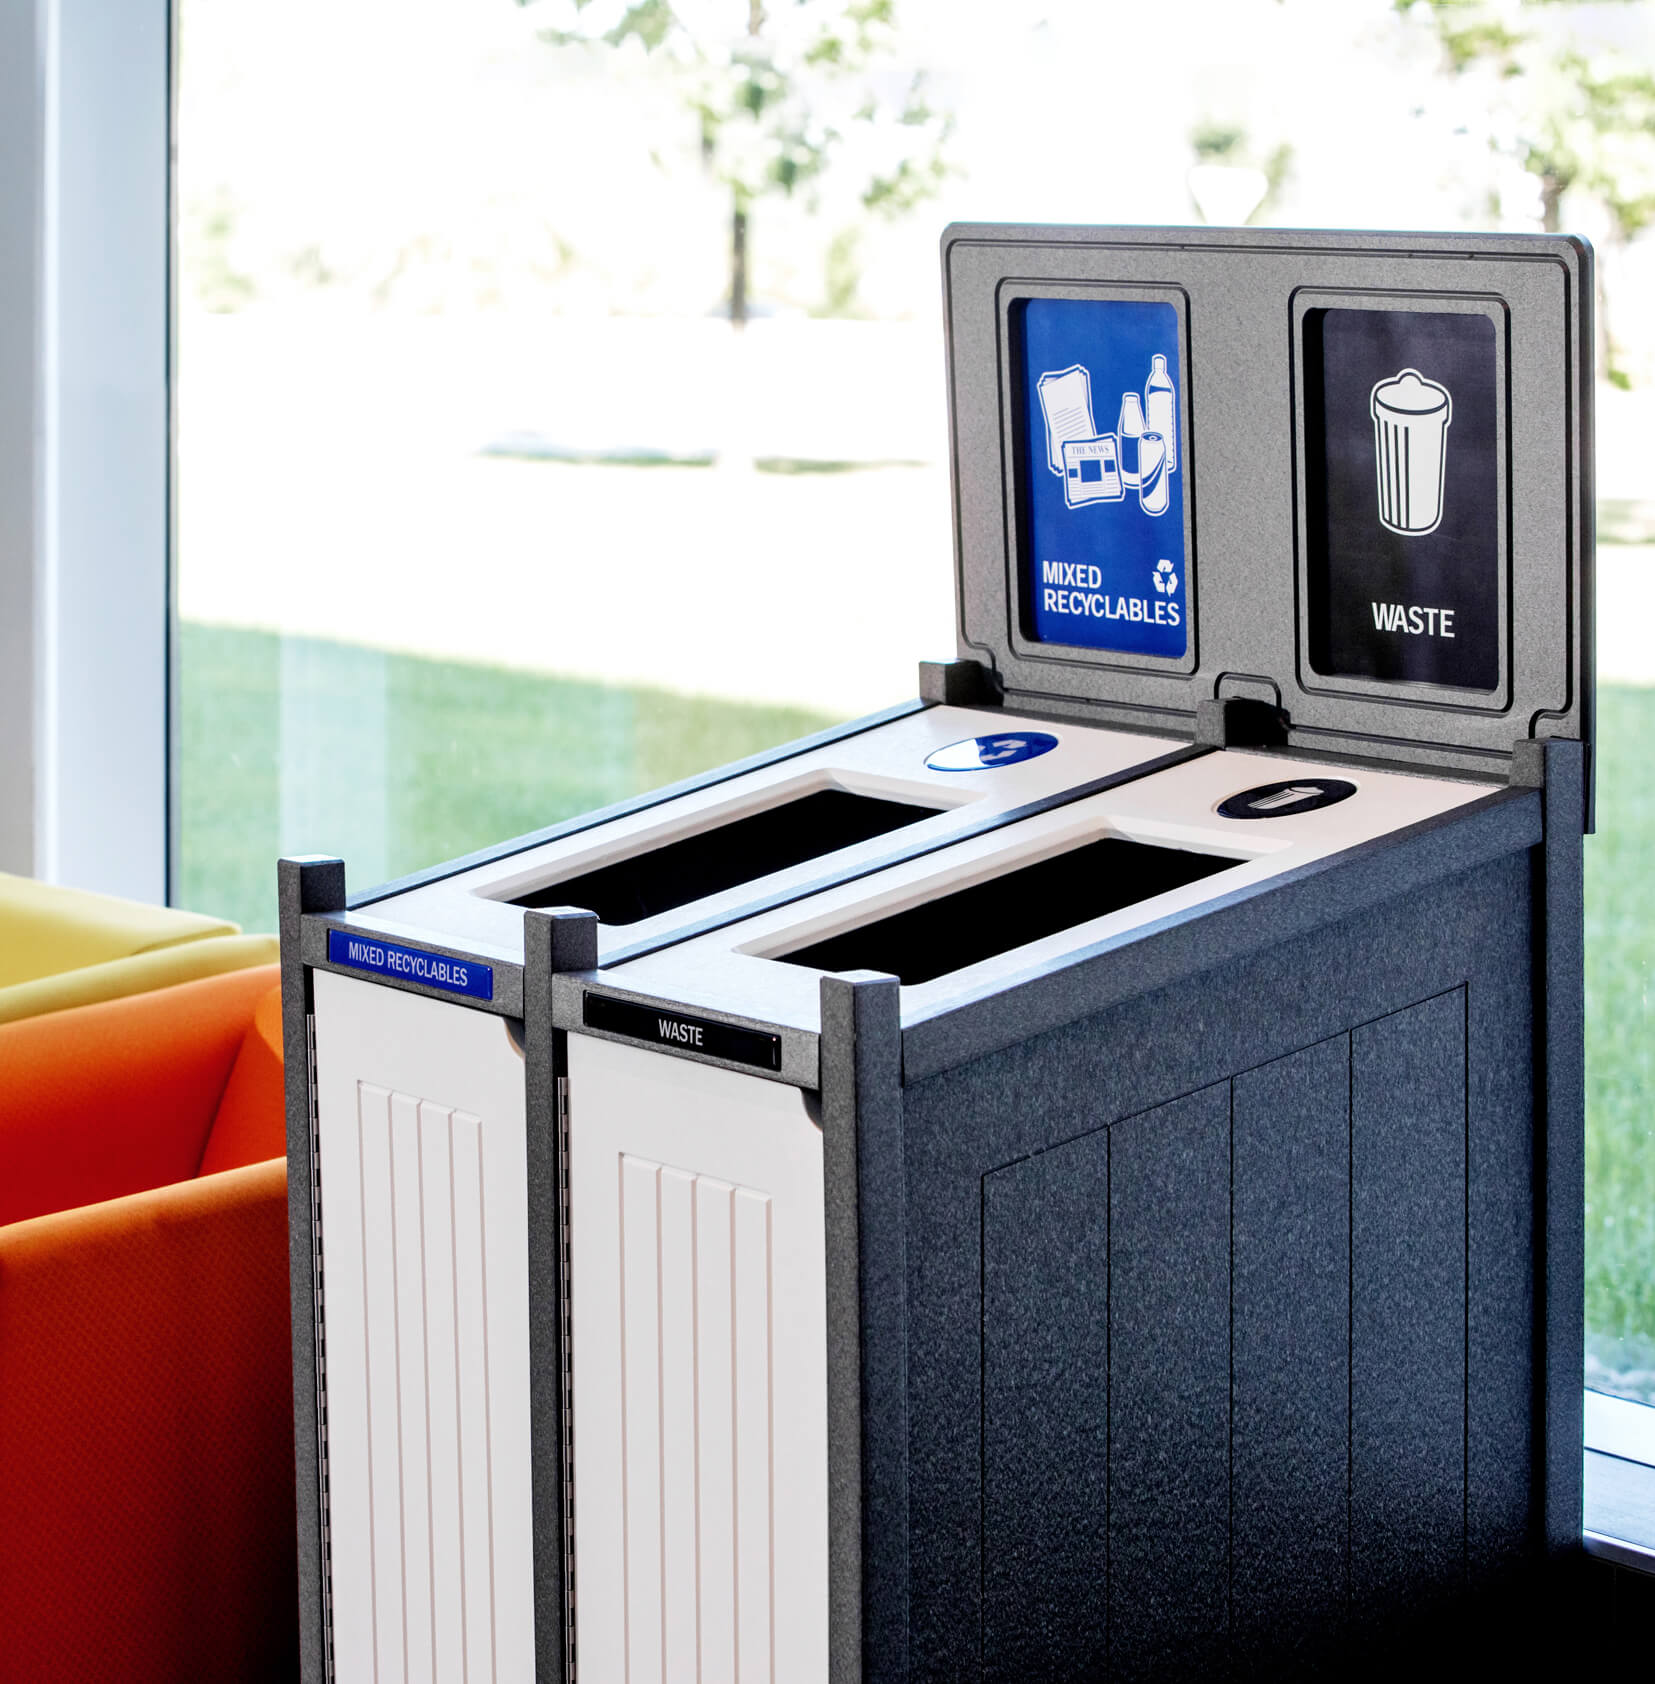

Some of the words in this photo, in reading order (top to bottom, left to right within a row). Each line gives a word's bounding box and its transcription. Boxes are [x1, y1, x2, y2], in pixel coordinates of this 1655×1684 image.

[1043, 560, 1102, 589] MIXED
[1044, 588, 1181, 626] RECYCLABLES
[1371, 602, 1456, 638] WASTE
[348, 941, 384, 966] MIXED
[387, 951, 468, 987] RECYCLABLES
[658, 1018, 704, 1046] WASTE
